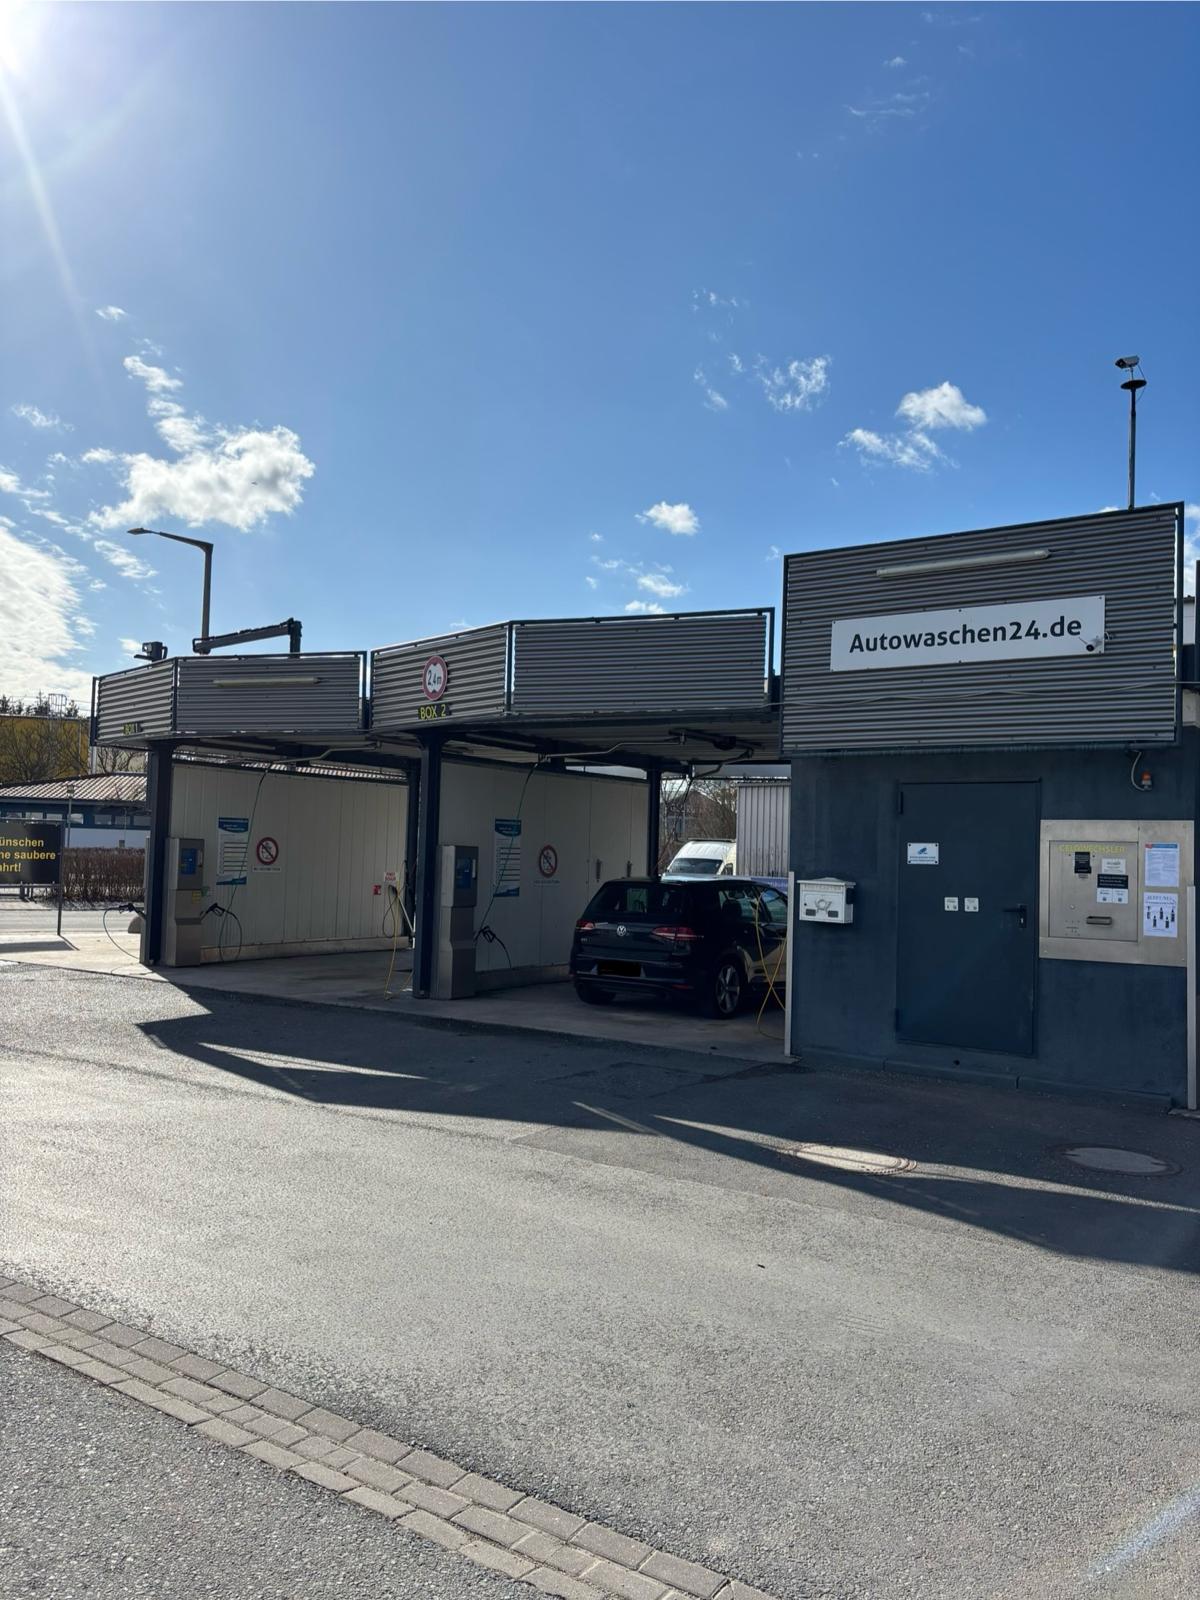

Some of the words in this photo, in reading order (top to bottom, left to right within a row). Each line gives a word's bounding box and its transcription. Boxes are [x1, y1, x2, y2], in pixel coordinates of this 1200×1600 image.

[849, 615, 1082, 653] Autowaschen24.de
[420, 706, 437, 719] BOX
[441, 704, 446, 718] 2
[14, 850, 56, 860] saubere
